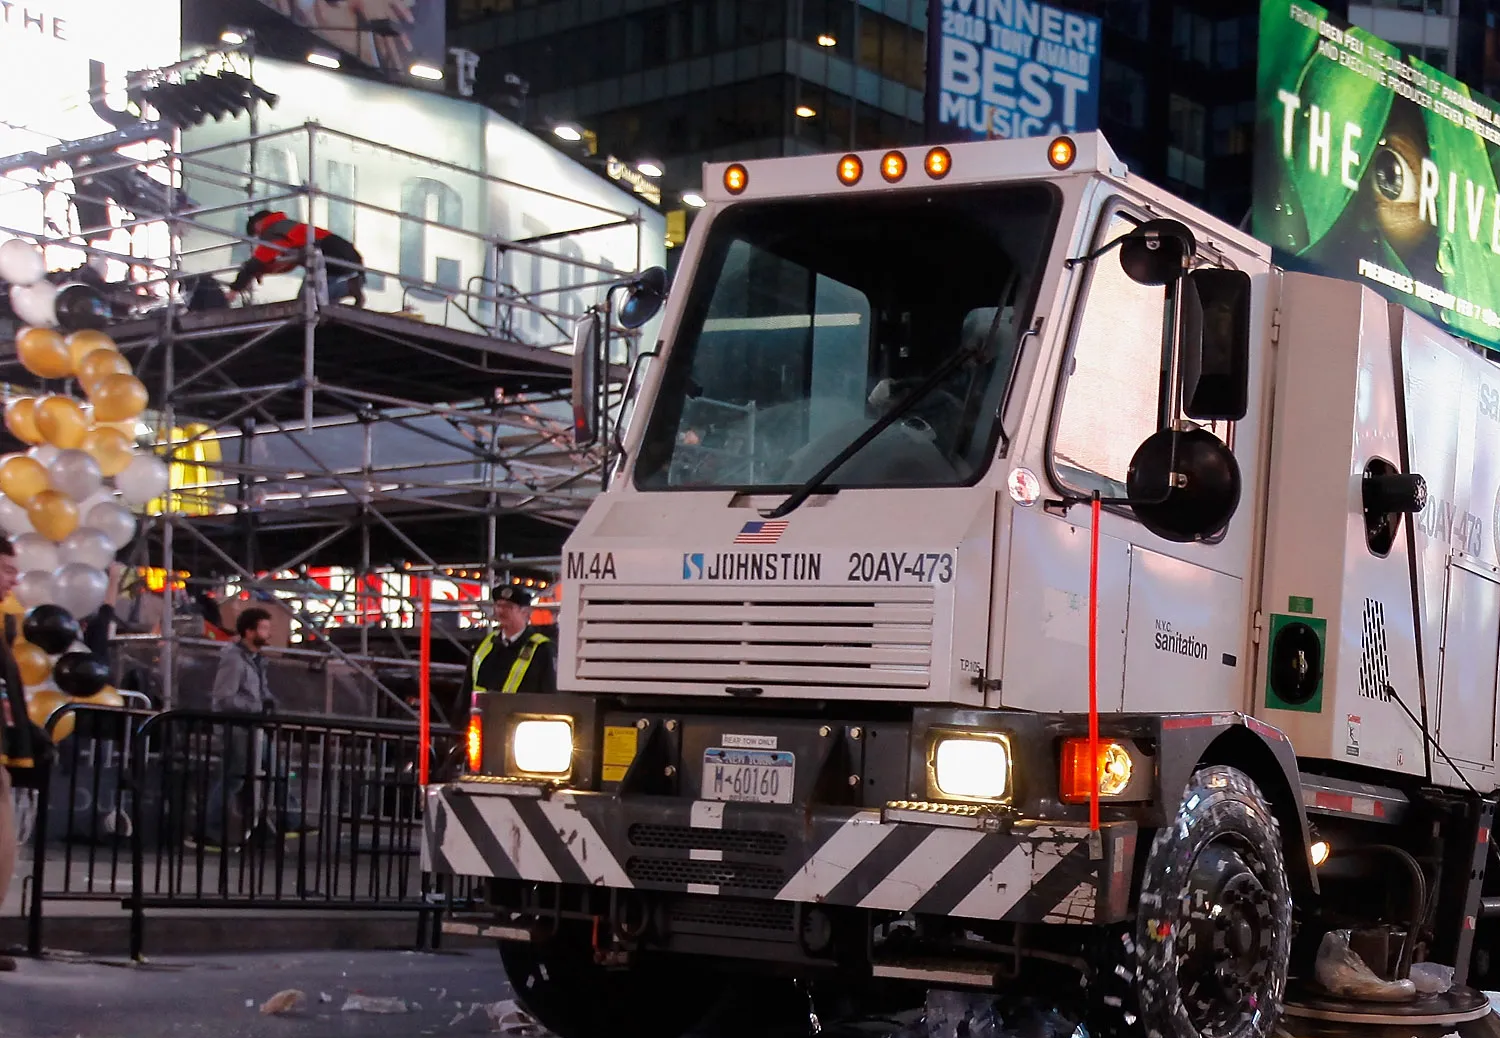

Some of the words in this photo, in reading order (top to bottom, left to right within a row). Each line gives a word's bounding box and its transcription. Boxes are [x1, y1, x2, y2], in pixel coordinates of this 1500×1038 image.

[1, 0, 68, 41] THE
[942, 9, 987, 44] 2010
[990, 23, 1034, 59] TONY
[1036, 39, 1090, 76] AWARD
[941, 36, 1089, 127] BEST
[1387, 75, 1432, 111] PRODUCER
[1433, 97, 1464, 127] STEVEN
[939, 91, 1078, 140] MUSICA
[1278, 89, 1362, 192] THE
[1417, 495, 1483, 557] 20AY-473
[567, 552, 617, 581] M.4A
[707, 552, 822, 581] JOHNSTON
[848, 552, 954, 584] 20AY-473
[1154, 632, 1208, 660] sanitation
[1155, 618, 1173, 633] N.Y.C.
[734, 767, 780, 797] 60160
